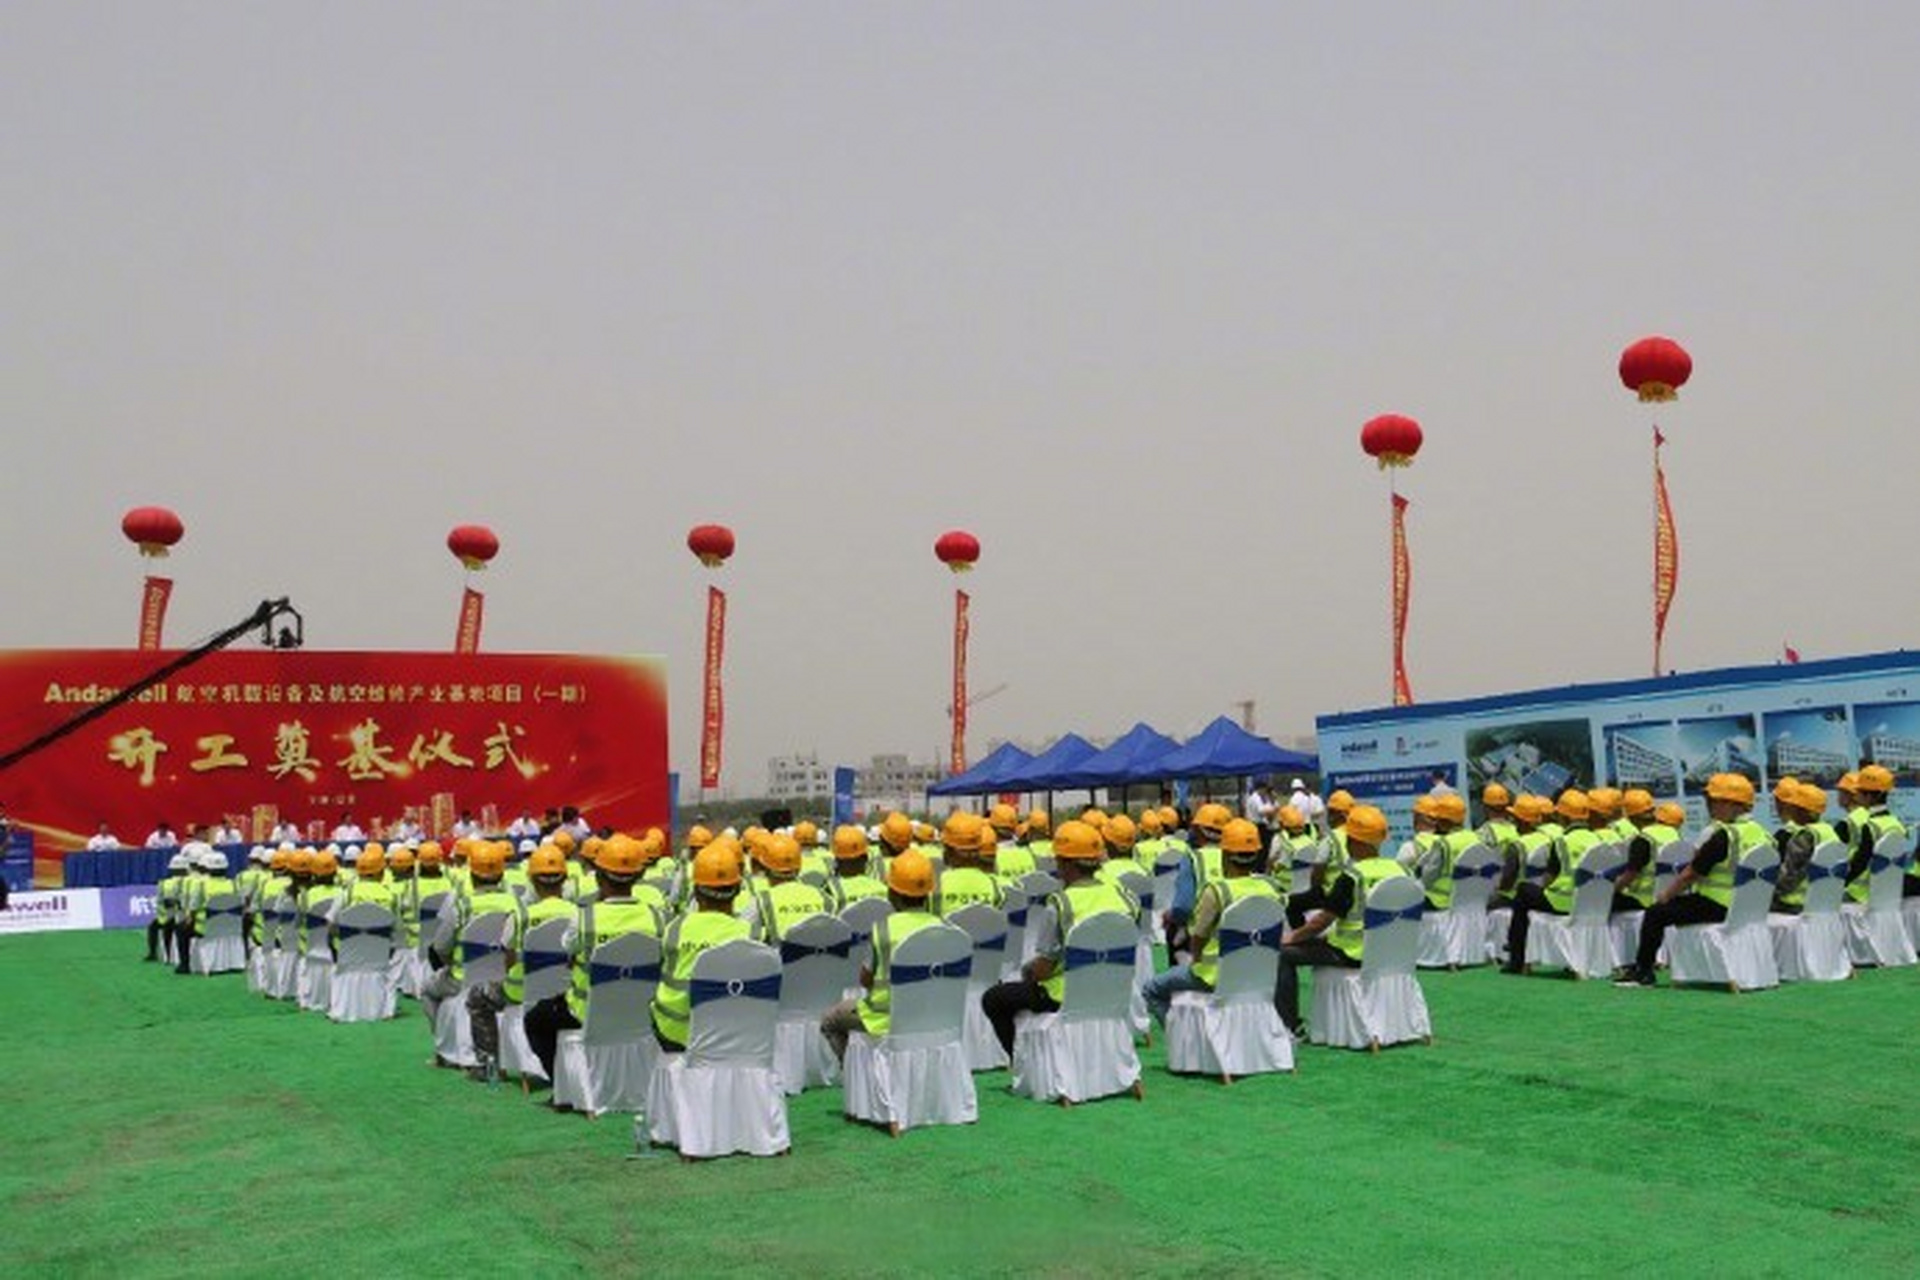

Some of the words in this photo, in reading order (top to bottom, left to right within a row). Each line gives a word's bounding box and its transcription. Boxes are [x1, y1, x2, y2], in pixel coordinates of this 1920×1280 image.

[107, 718, 536, 786] 开工奠基仪式
